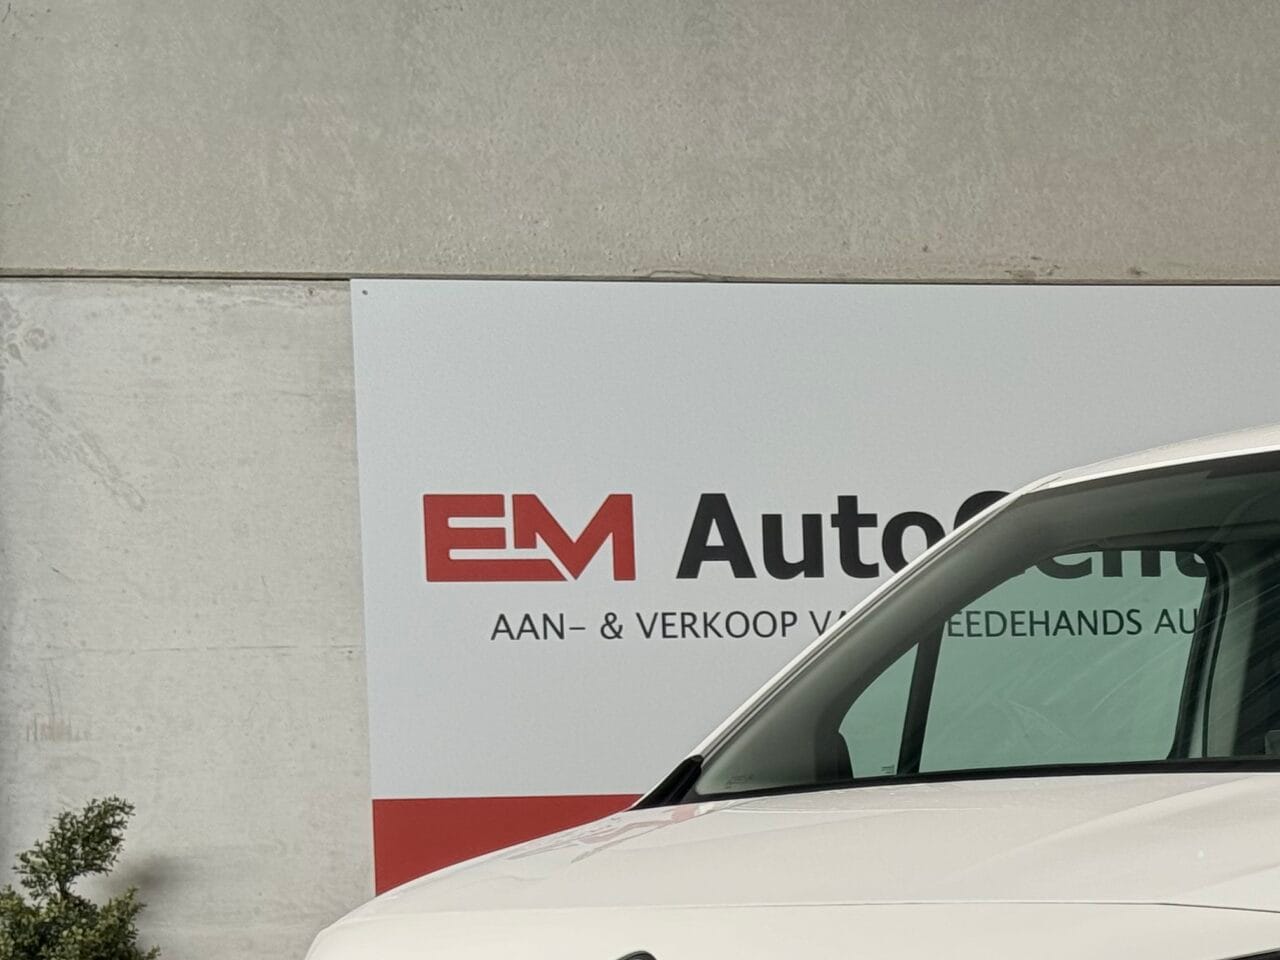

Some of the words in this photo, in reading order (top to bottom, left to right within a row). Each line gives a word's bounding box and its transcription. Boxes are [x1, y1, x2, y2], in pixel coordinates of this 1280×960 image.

[423, 494, 636, 582] EM
[600, 612, 634, 640] &
[636, 610, 798, 639] VERKOOP
[947, 609, 1142, 637] EEDEHANDS
[1154, 608, 1199, 634] AU
